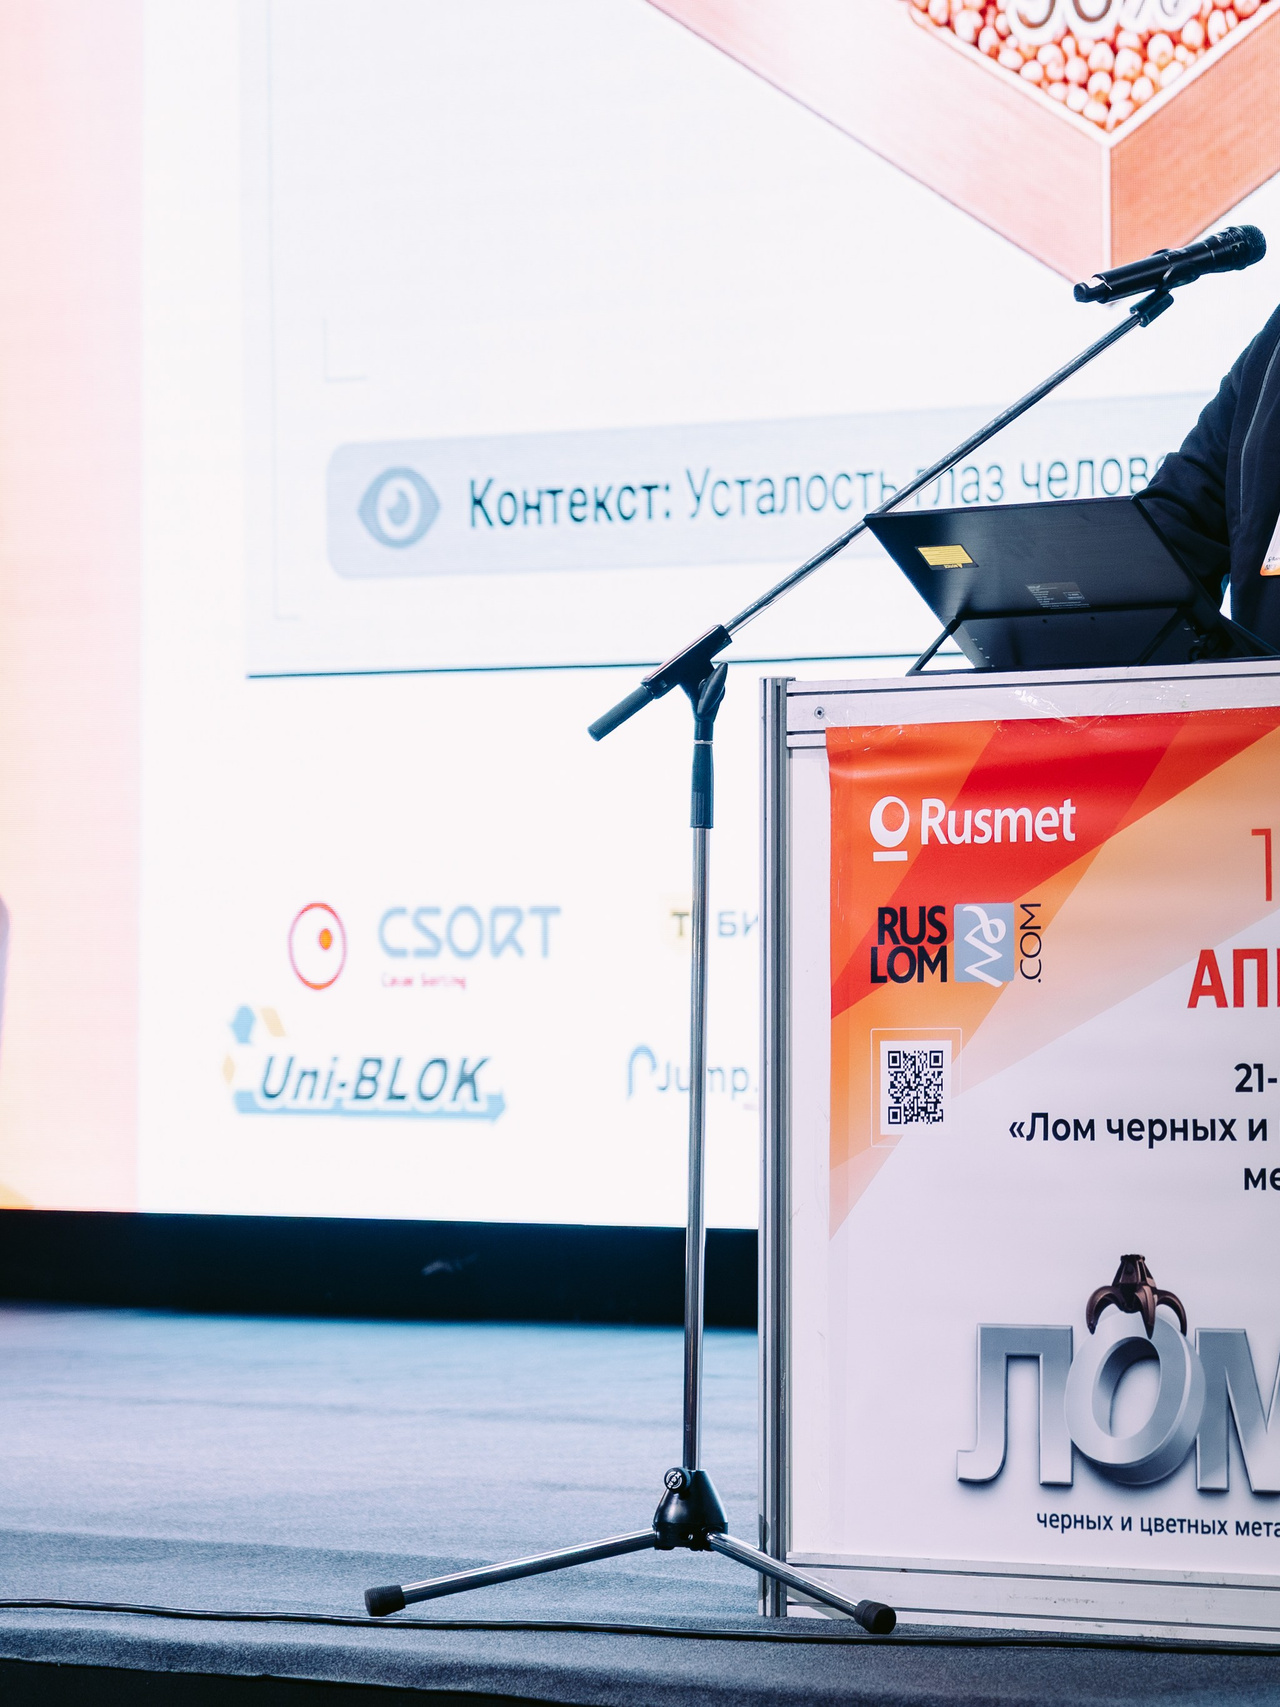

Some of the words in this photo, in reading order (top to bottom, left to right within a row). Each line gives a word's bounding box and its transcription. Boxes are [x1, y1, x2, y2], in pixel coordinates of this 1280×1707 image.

[468, 477, 672, 529] Контекст:
[685, 466, 899, 521] Усталость
[1021, 453, 1165, 500] челов
[920, 798, 1076, 845] Rusmet
[378, 905, 562, 960] CSORT
[877, 905, 948, 946] RUS
[870, 945, 948, 984] LOM
[262, 1056, 491, 1101] Uni-BLOK
[1008, 1111, 1096, 1143] «Лом
[1105, 1117, 1237, 1149] черных
[1248, 1117, 1268, 1142] и
[1036, 1512, 1114, 1534] черных
[1120, 1516, 1133, 1532] и
[1140, 1515, 1228, 1536] цветных
